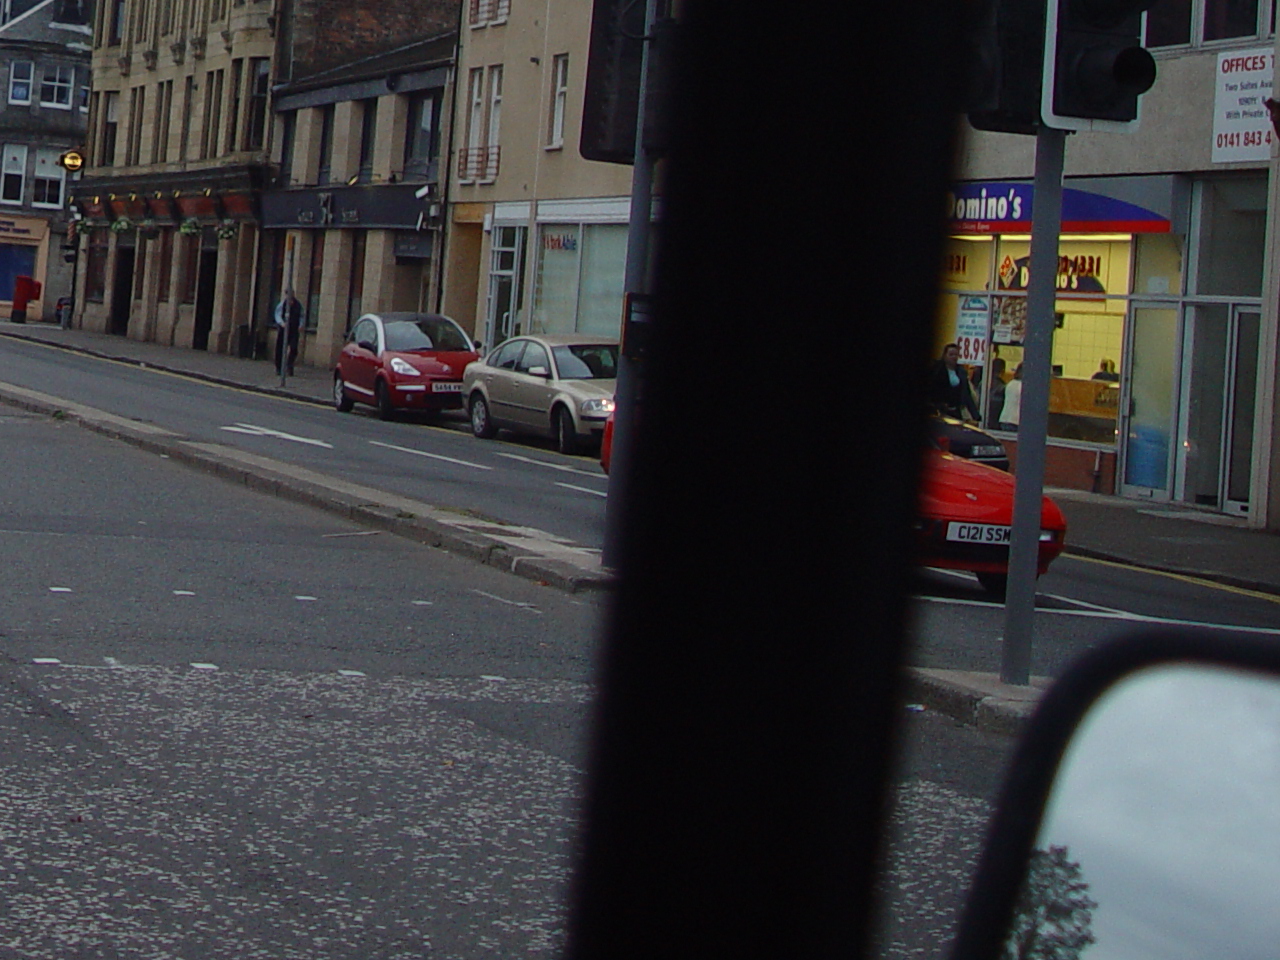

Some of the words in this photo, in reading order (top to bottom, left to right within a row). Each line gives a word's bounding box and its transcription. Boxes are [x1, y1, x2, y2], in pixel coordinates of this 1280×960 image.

[1221, 55, 1266, 74] OFFICES
[1225, 83, 1238, 92] Two
[1240, 81, 1258, 91] Suites
[1260, 80, 1273, 89] Ava
[1225, 111, 1240, 119] With
[1242, 109, 1264, 119] Private
[1216, 132, 1240, 148] 0141
[1243, 130, 1262, 147] 843
[1265, 130, 1272, 145] 4
